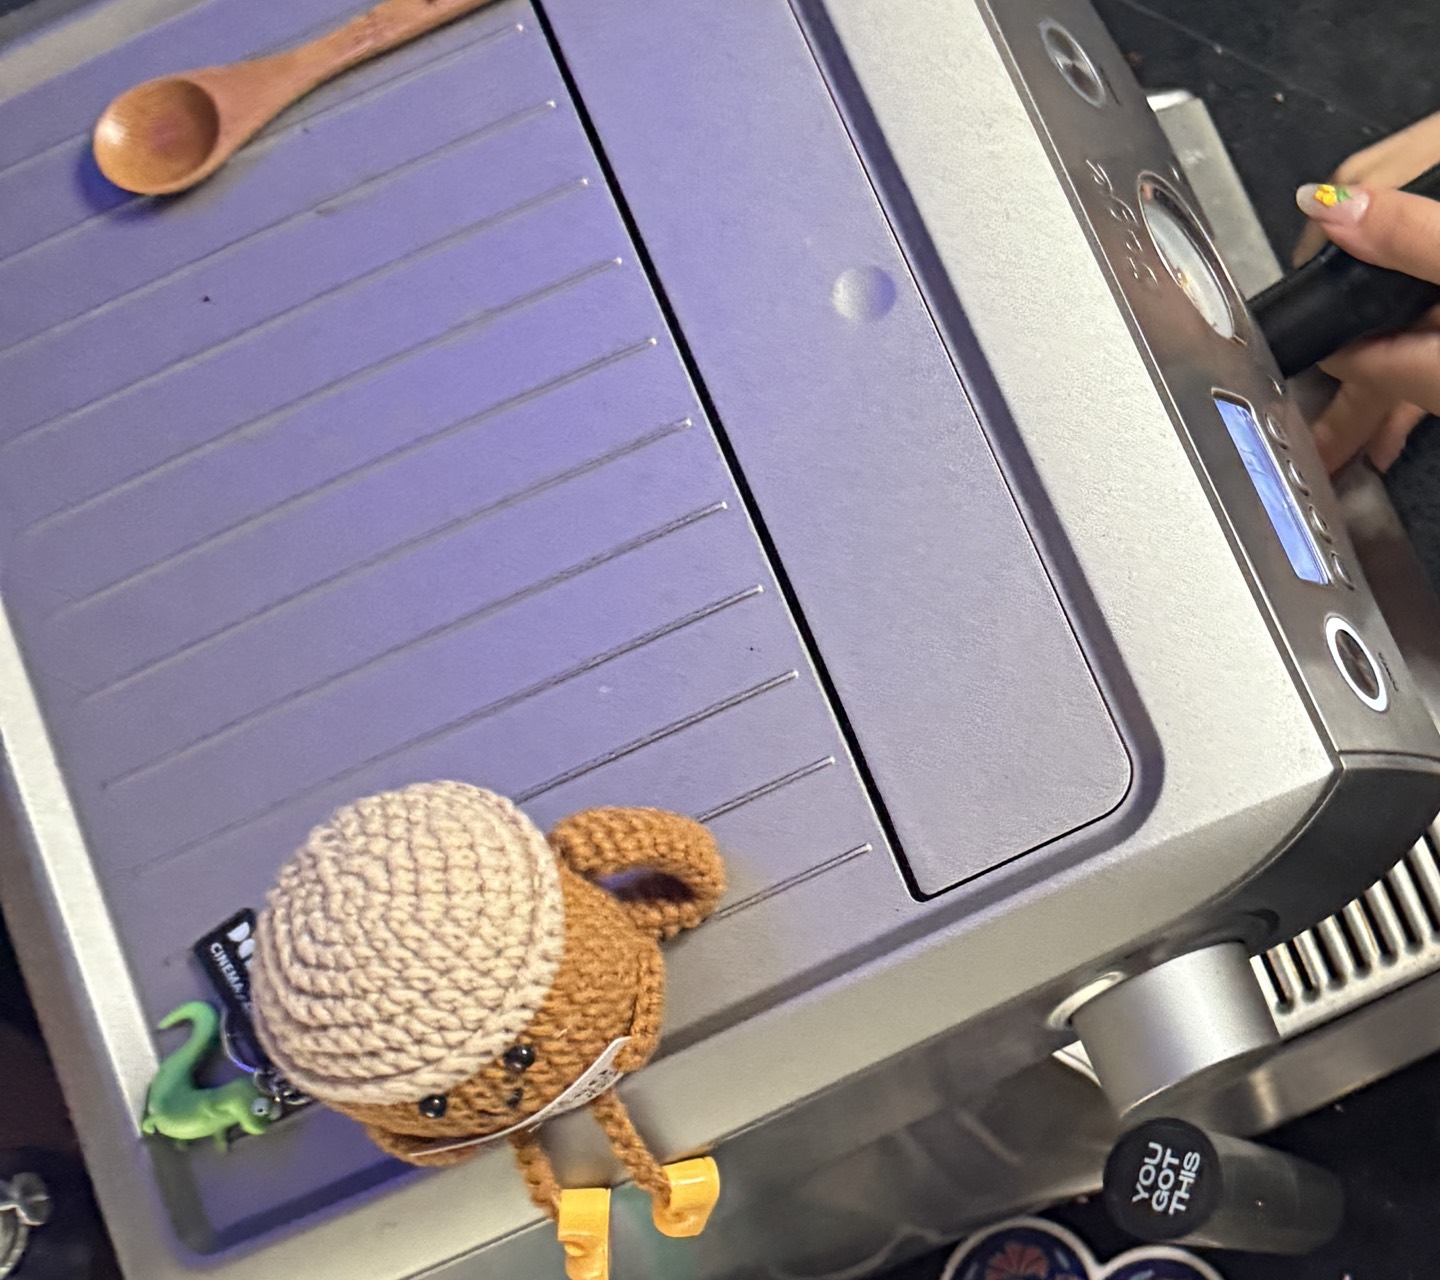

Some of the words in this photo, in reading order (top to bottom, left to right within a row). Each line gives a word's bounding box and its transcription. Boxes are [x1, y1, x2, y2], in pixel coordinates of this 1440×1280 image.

[210, 941, 245, 994] CINEMA
[1132, 1141, 1163, 1203] YOU
[1151, 1147, 1180, 1212] GOT
[1168, 1150, 1201, 1215] THIS
